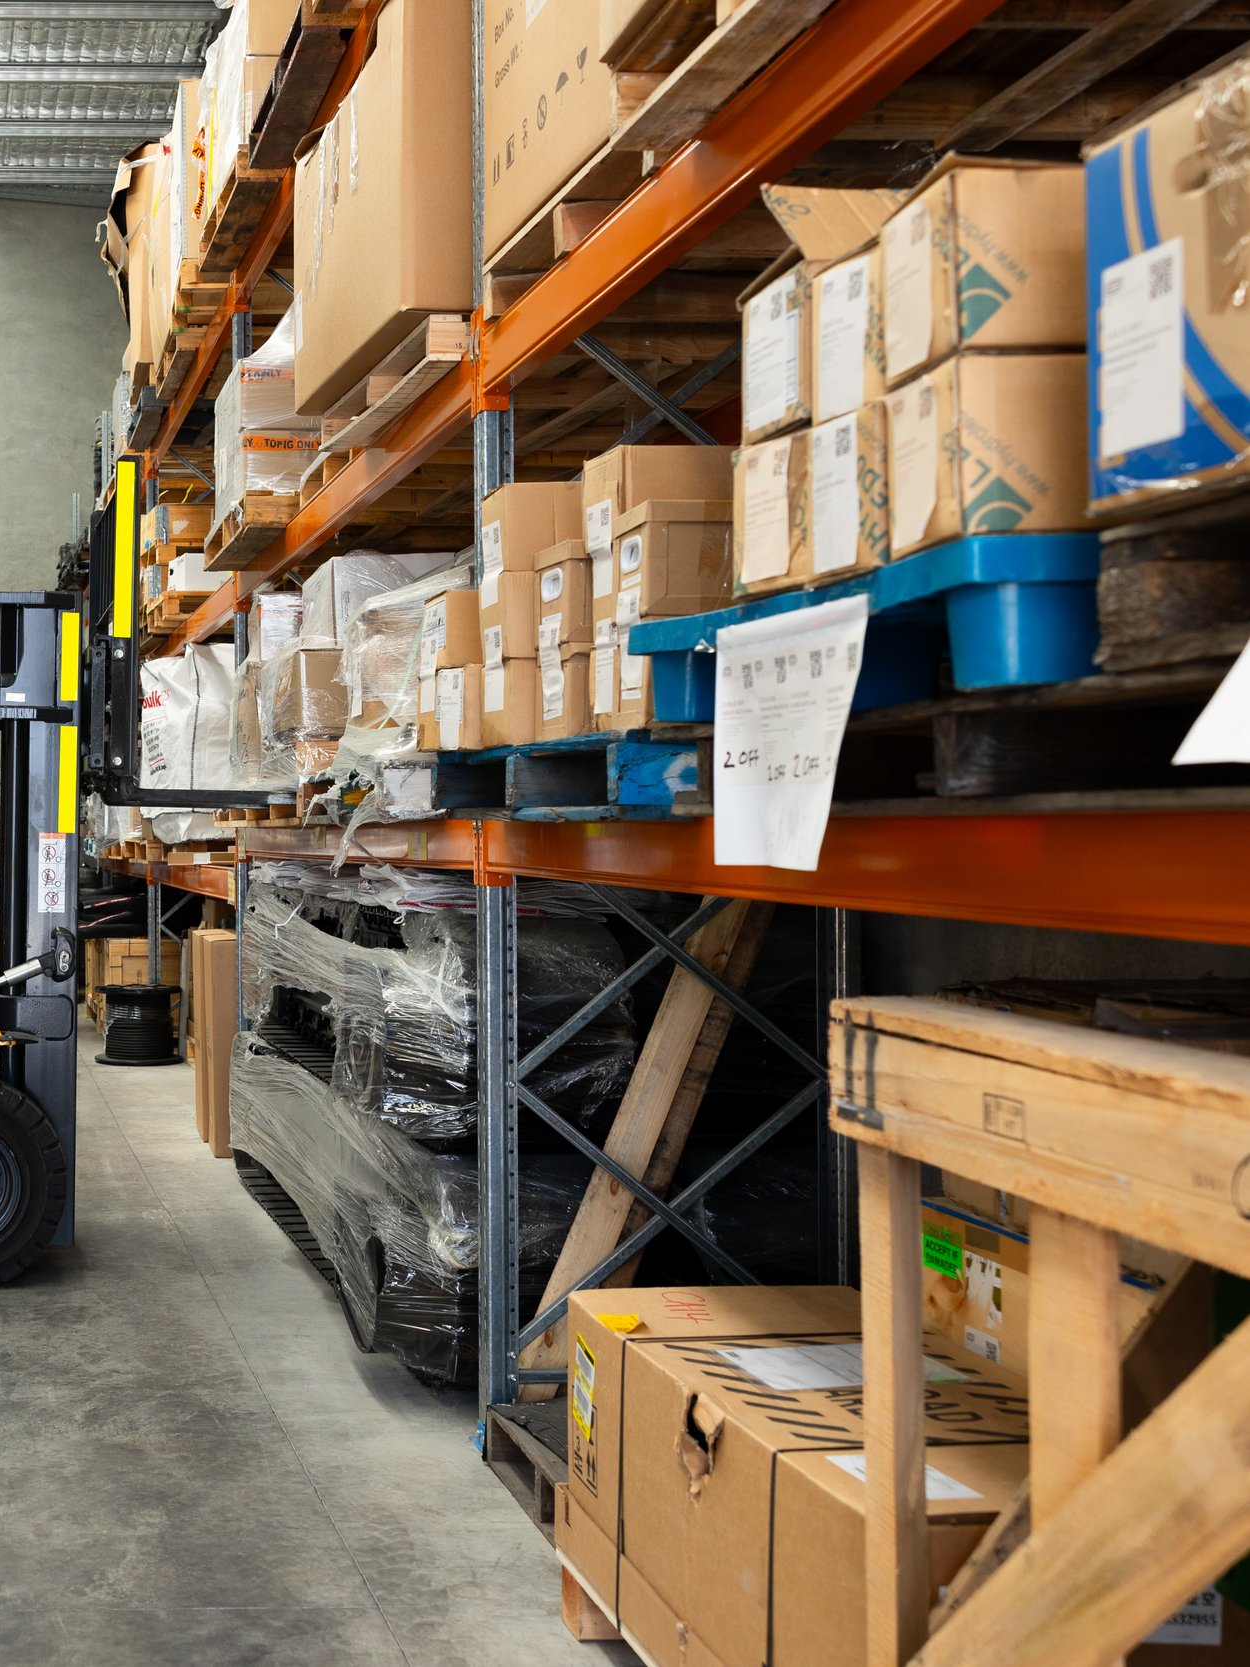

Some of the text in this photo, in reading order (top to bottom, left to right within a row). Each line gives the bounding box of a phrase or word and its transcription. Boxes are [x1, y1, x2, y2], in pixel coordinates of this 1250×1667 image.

[495, 22, 504, 44] Box
[495, 58, 510, 88] Gross
[723, 751, 736, 769] 2
[925, 1239, 952, 1258] ACCEPT
